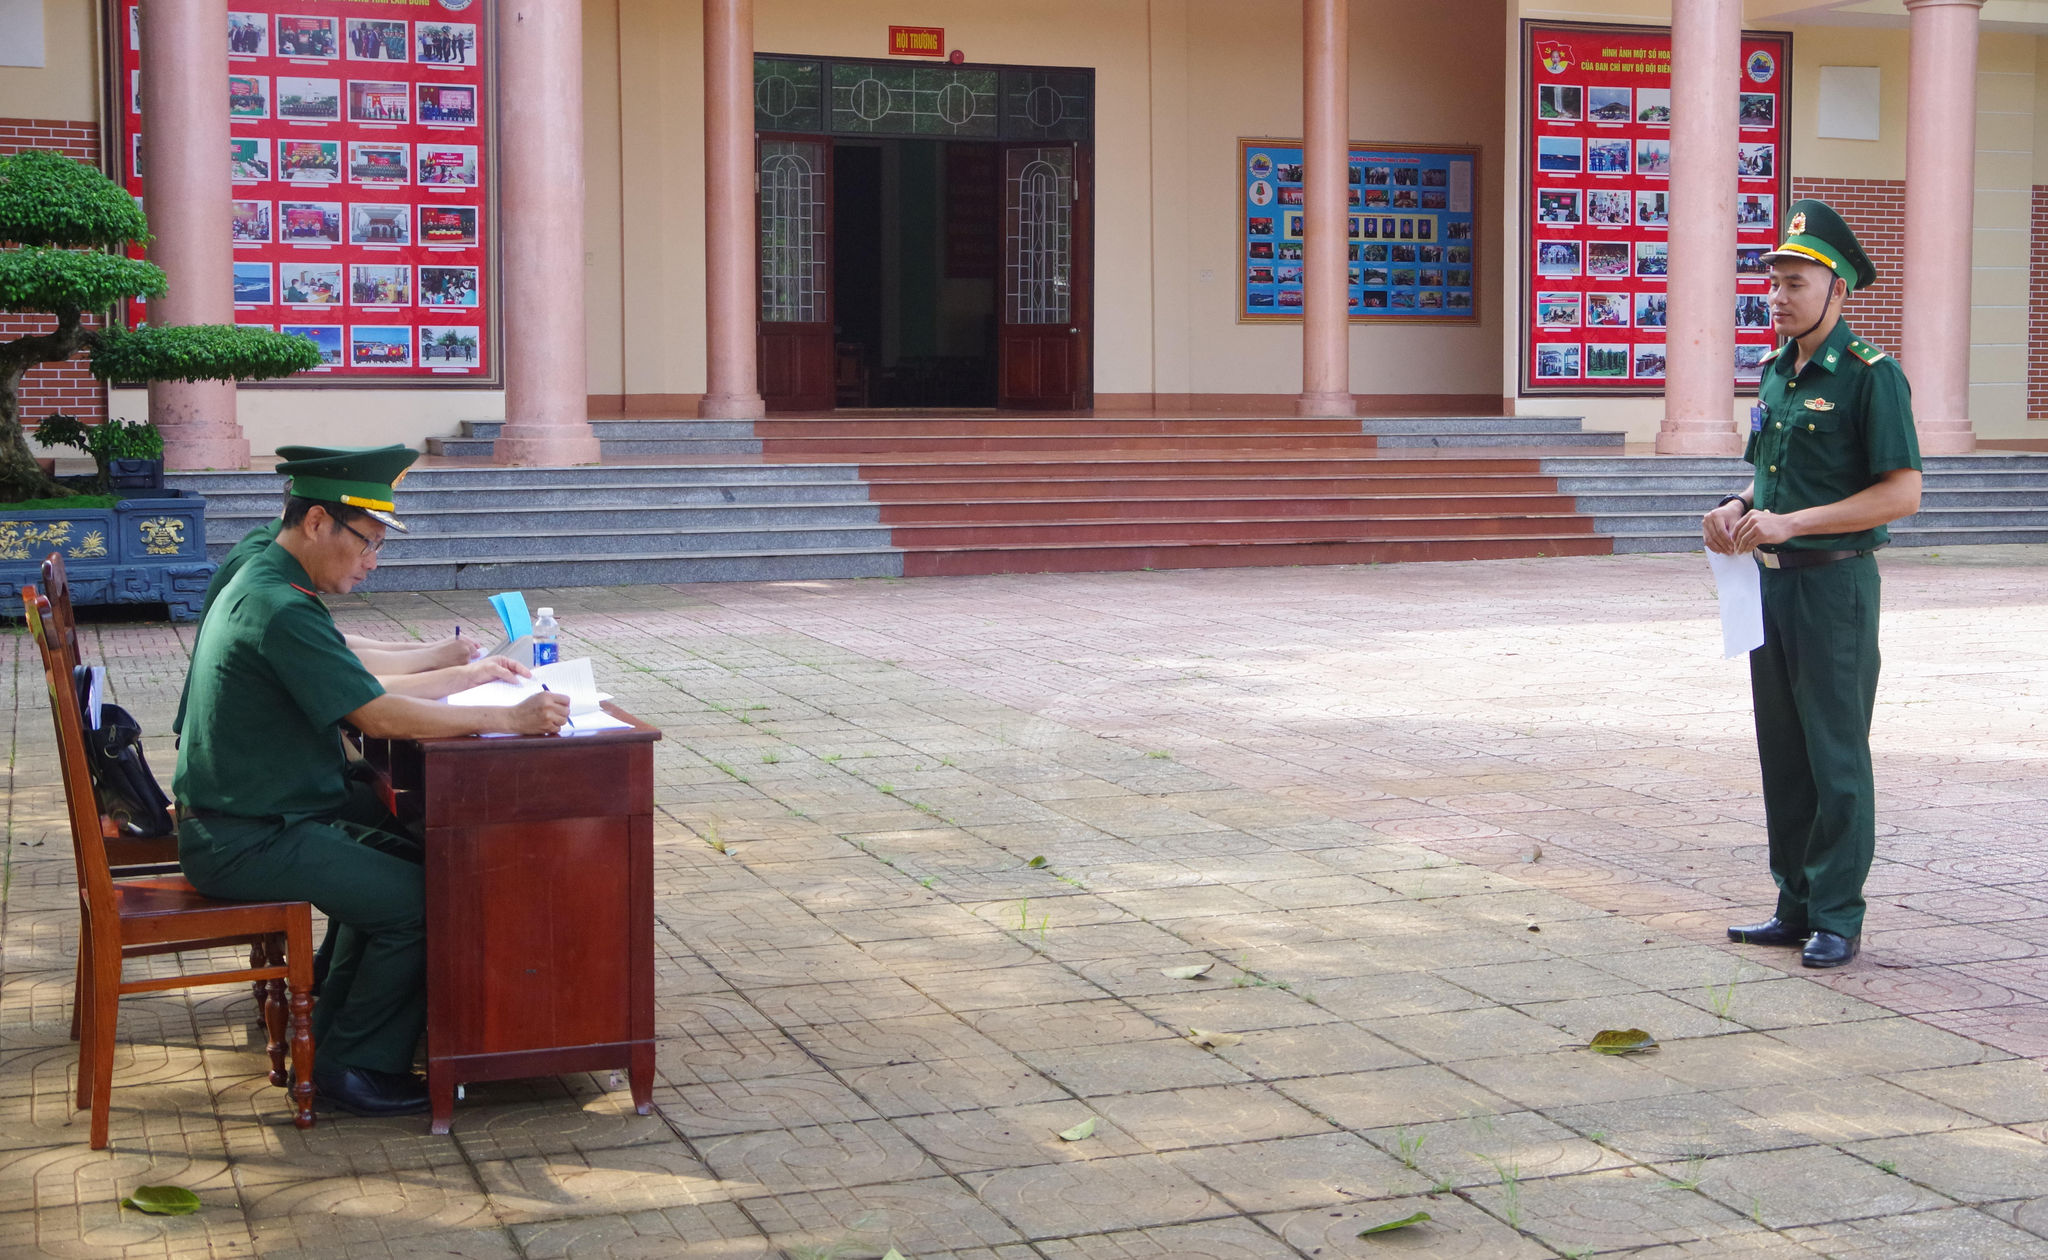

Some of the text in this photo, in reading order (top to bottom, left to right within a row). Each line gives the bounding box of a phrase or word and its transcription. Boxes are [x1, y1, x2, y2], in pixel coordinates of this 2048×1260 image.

[896, 29, 938, 52] HỘI TRƯỜNG
[1602, 46, 1672, 62] HÌNH ẢNH MỘT SỐ HOẠ
[1581, 59, 1594, 71] CỦA
[1595, 62, 1608, 71] BAN
[1609, 60, 1621, 72] CHỈ
[1622, 63, 1634, 72] HUY
[1636, 62, 1644, 74] BỘ
[1645, 62, 1656, 75] ĐỘI
